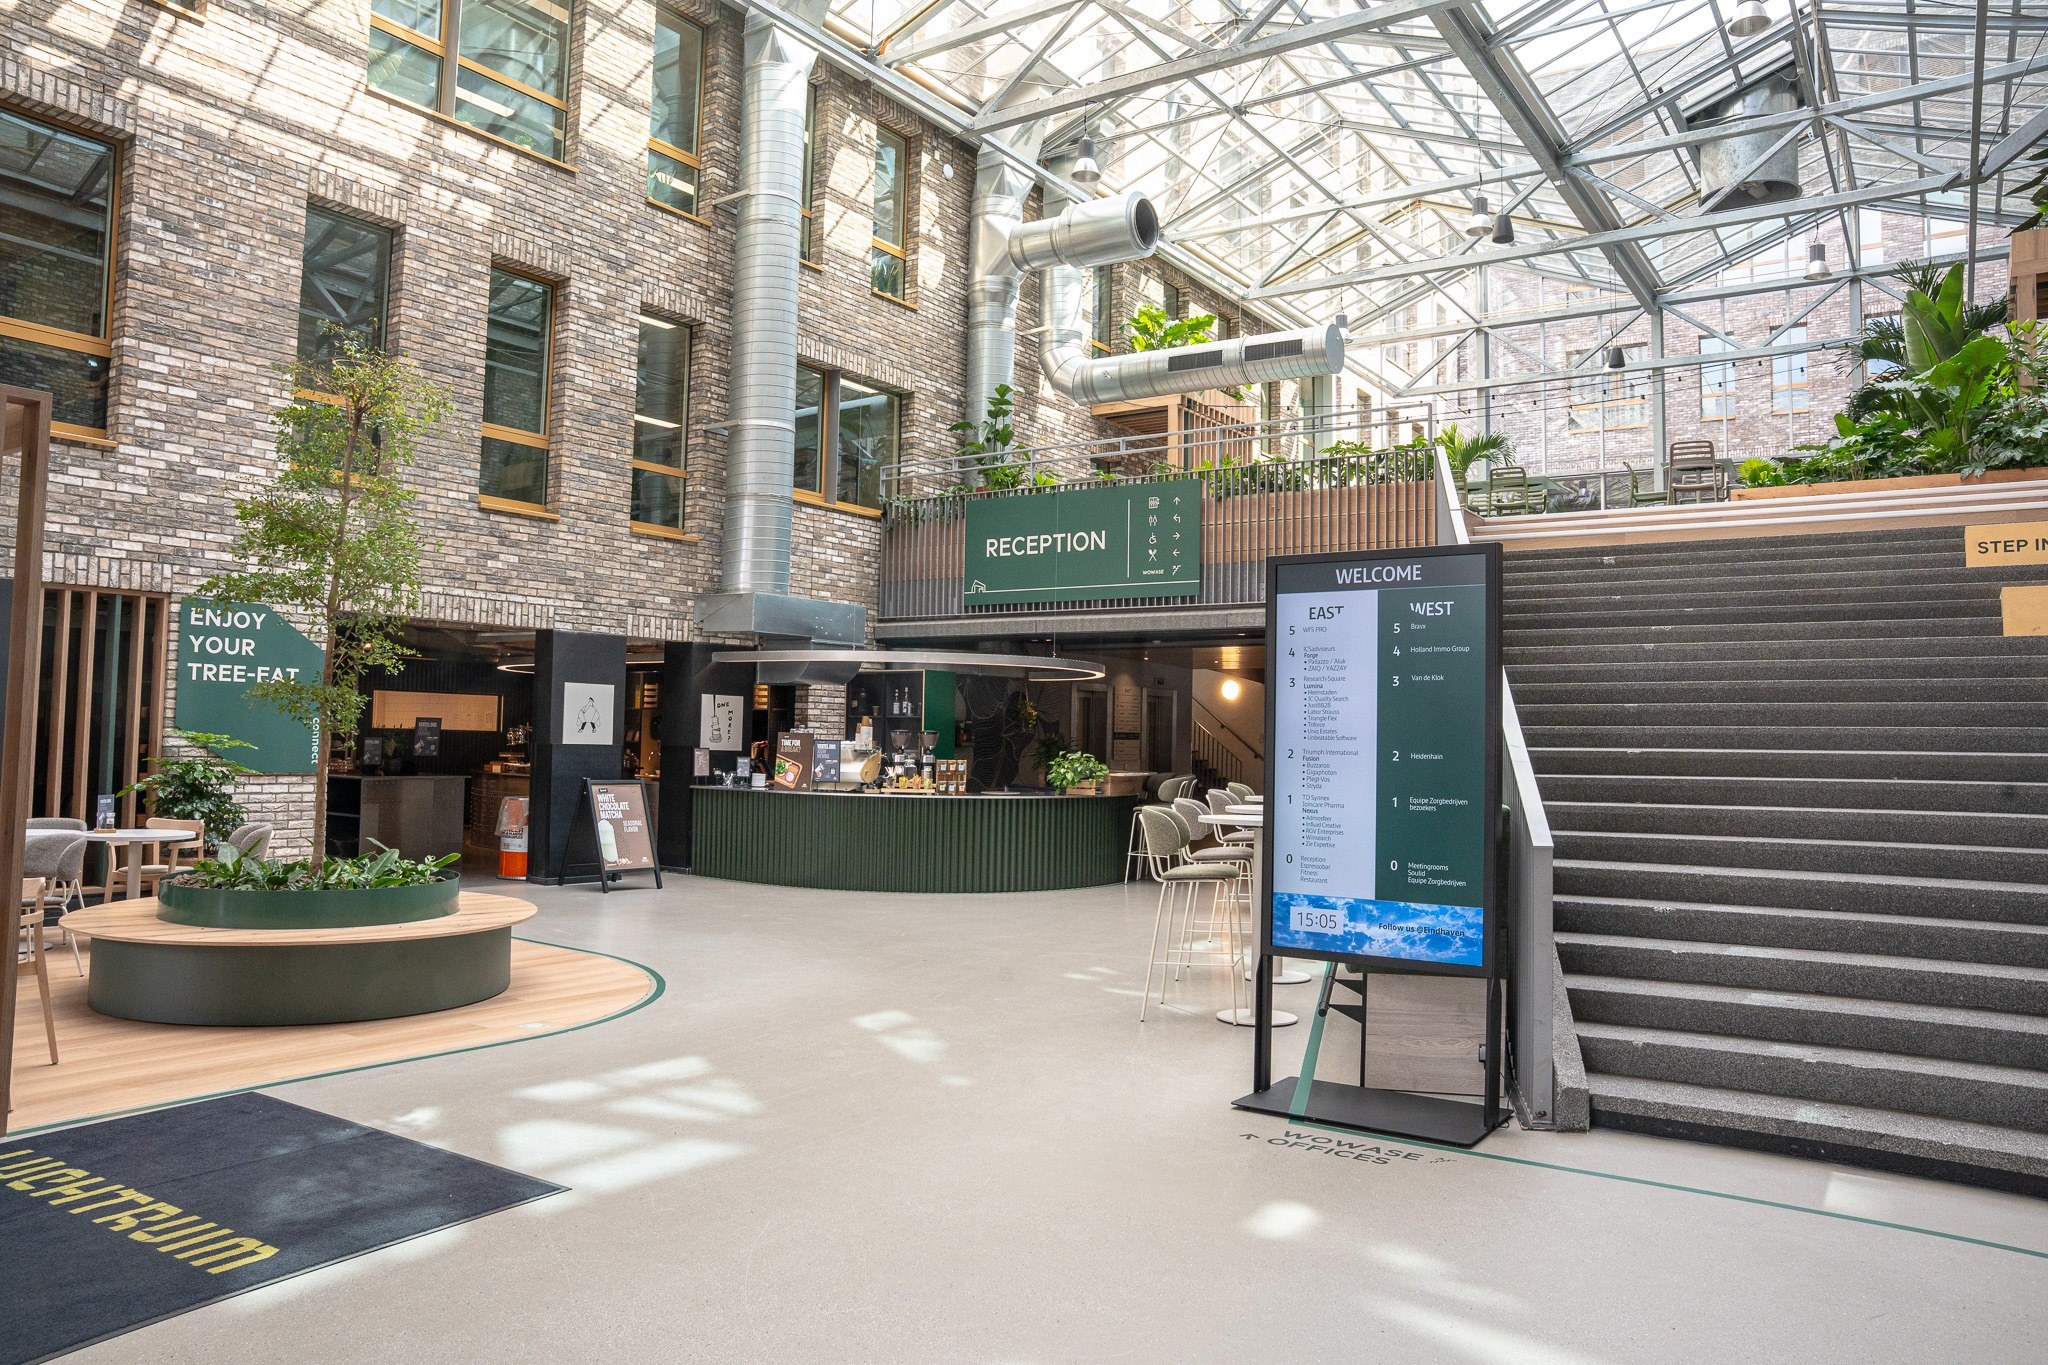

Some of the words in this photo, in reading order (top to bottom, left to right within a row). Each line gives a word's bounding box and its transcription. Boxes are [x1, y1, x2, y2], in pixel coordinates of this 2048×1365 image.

[986, 530, 1106, 558] RECEPTION
[1978, 539, 2028, 554] STEP
[1335, 564, 1422, 584] WELCOME
[1309, 606, 1344, 620] EAST
[1410, 602, 1454, 616] WEST
[190, 608, 267, 630] ENJOY
[1289, 626, 1296, 636] 5
[1393, 623, 1400, 634] 5
[189, 634, 256, 656] YOUR
[1288, 648, 1295, 657] 4
[1393, 646, 1400, 656] 4
[187, 662, 300, 684] TREE-EAT
[1289, 678, 1295, 688] 3
[1392, 676, 1400, 686] 3
[310, 717, 320, 764] connect
[1288, 748, 1294, 759] 2
[1392, 750, 1400, 761] 2
[597, 794, 615, 802] WHITE
[1288, 795, 1292, 804] 1
[1392, 797, 1397, 808] 1
[1430, 798, 1468, 806] Zorgbedrijven
[599, 802, 630, 810] CHOCOLATE
[600, 810, 623, 819] MATCHA
[1286, 854, 1292, 864] 0
[1390, 860, 1398, 871] 0
[1408, 862, 1449, 871] Meetingrooms
[1428, 878, 1466, 887] Zorgbedrijven
[1297, 912, 1336, 929] 15:05
[1379, 922, 1404, 932] Follow
[1416, 926, 1465, 937] @Eindhaven
[1267, 1138, 1391, 1165] OFFICES
[1284, 1130, 1424, 1162] WOWASE
